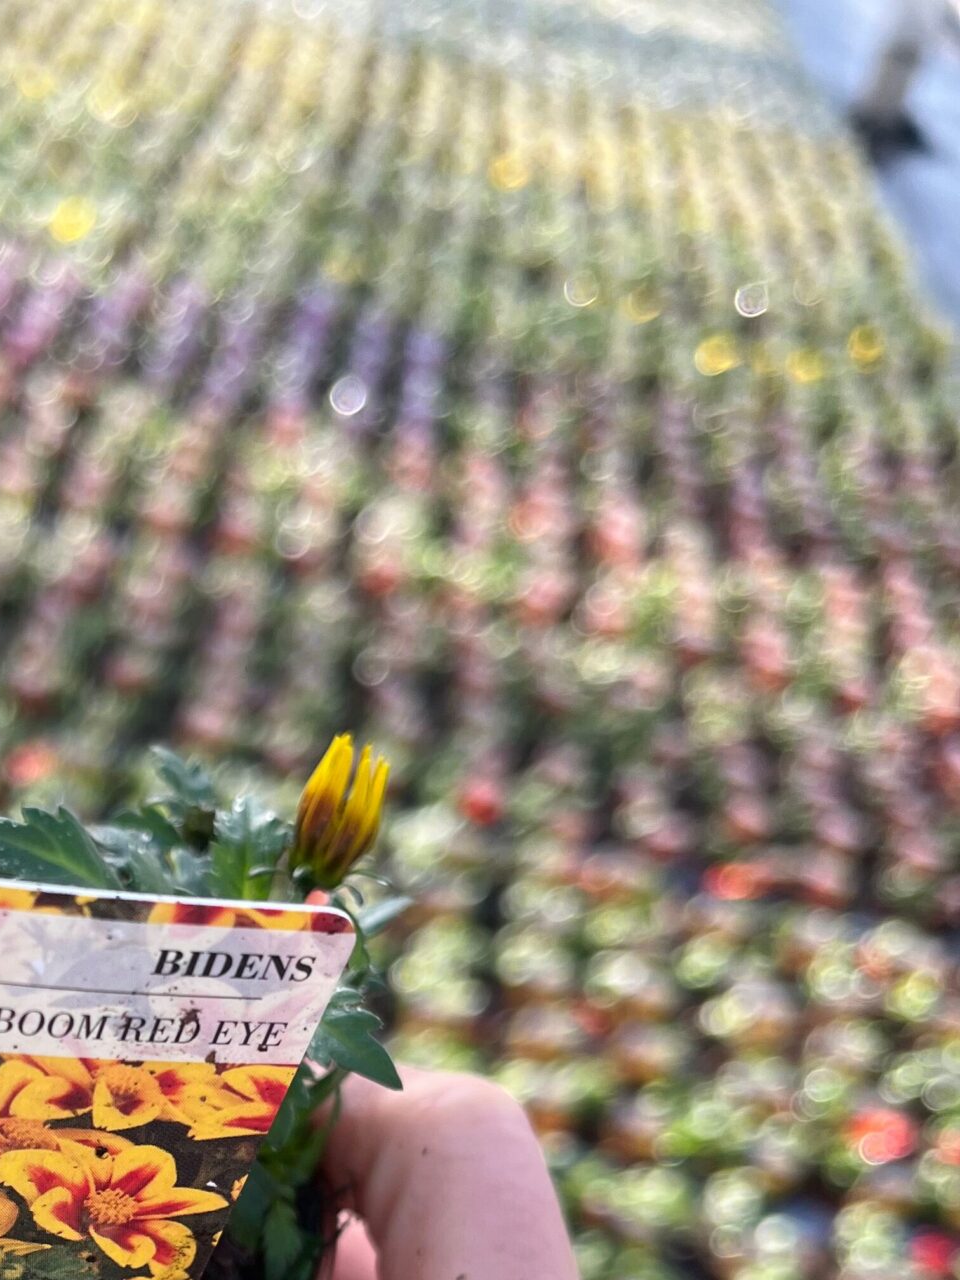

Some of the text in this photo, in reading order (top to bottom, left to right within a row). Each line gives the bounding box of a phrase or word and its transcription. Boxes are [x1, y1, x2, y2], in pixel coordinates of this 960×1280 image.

[151, 949, 315, 982] BIDENS
[120, 1015, 201, 1046] RED
[209, 1020, 288, 1048] EYE
